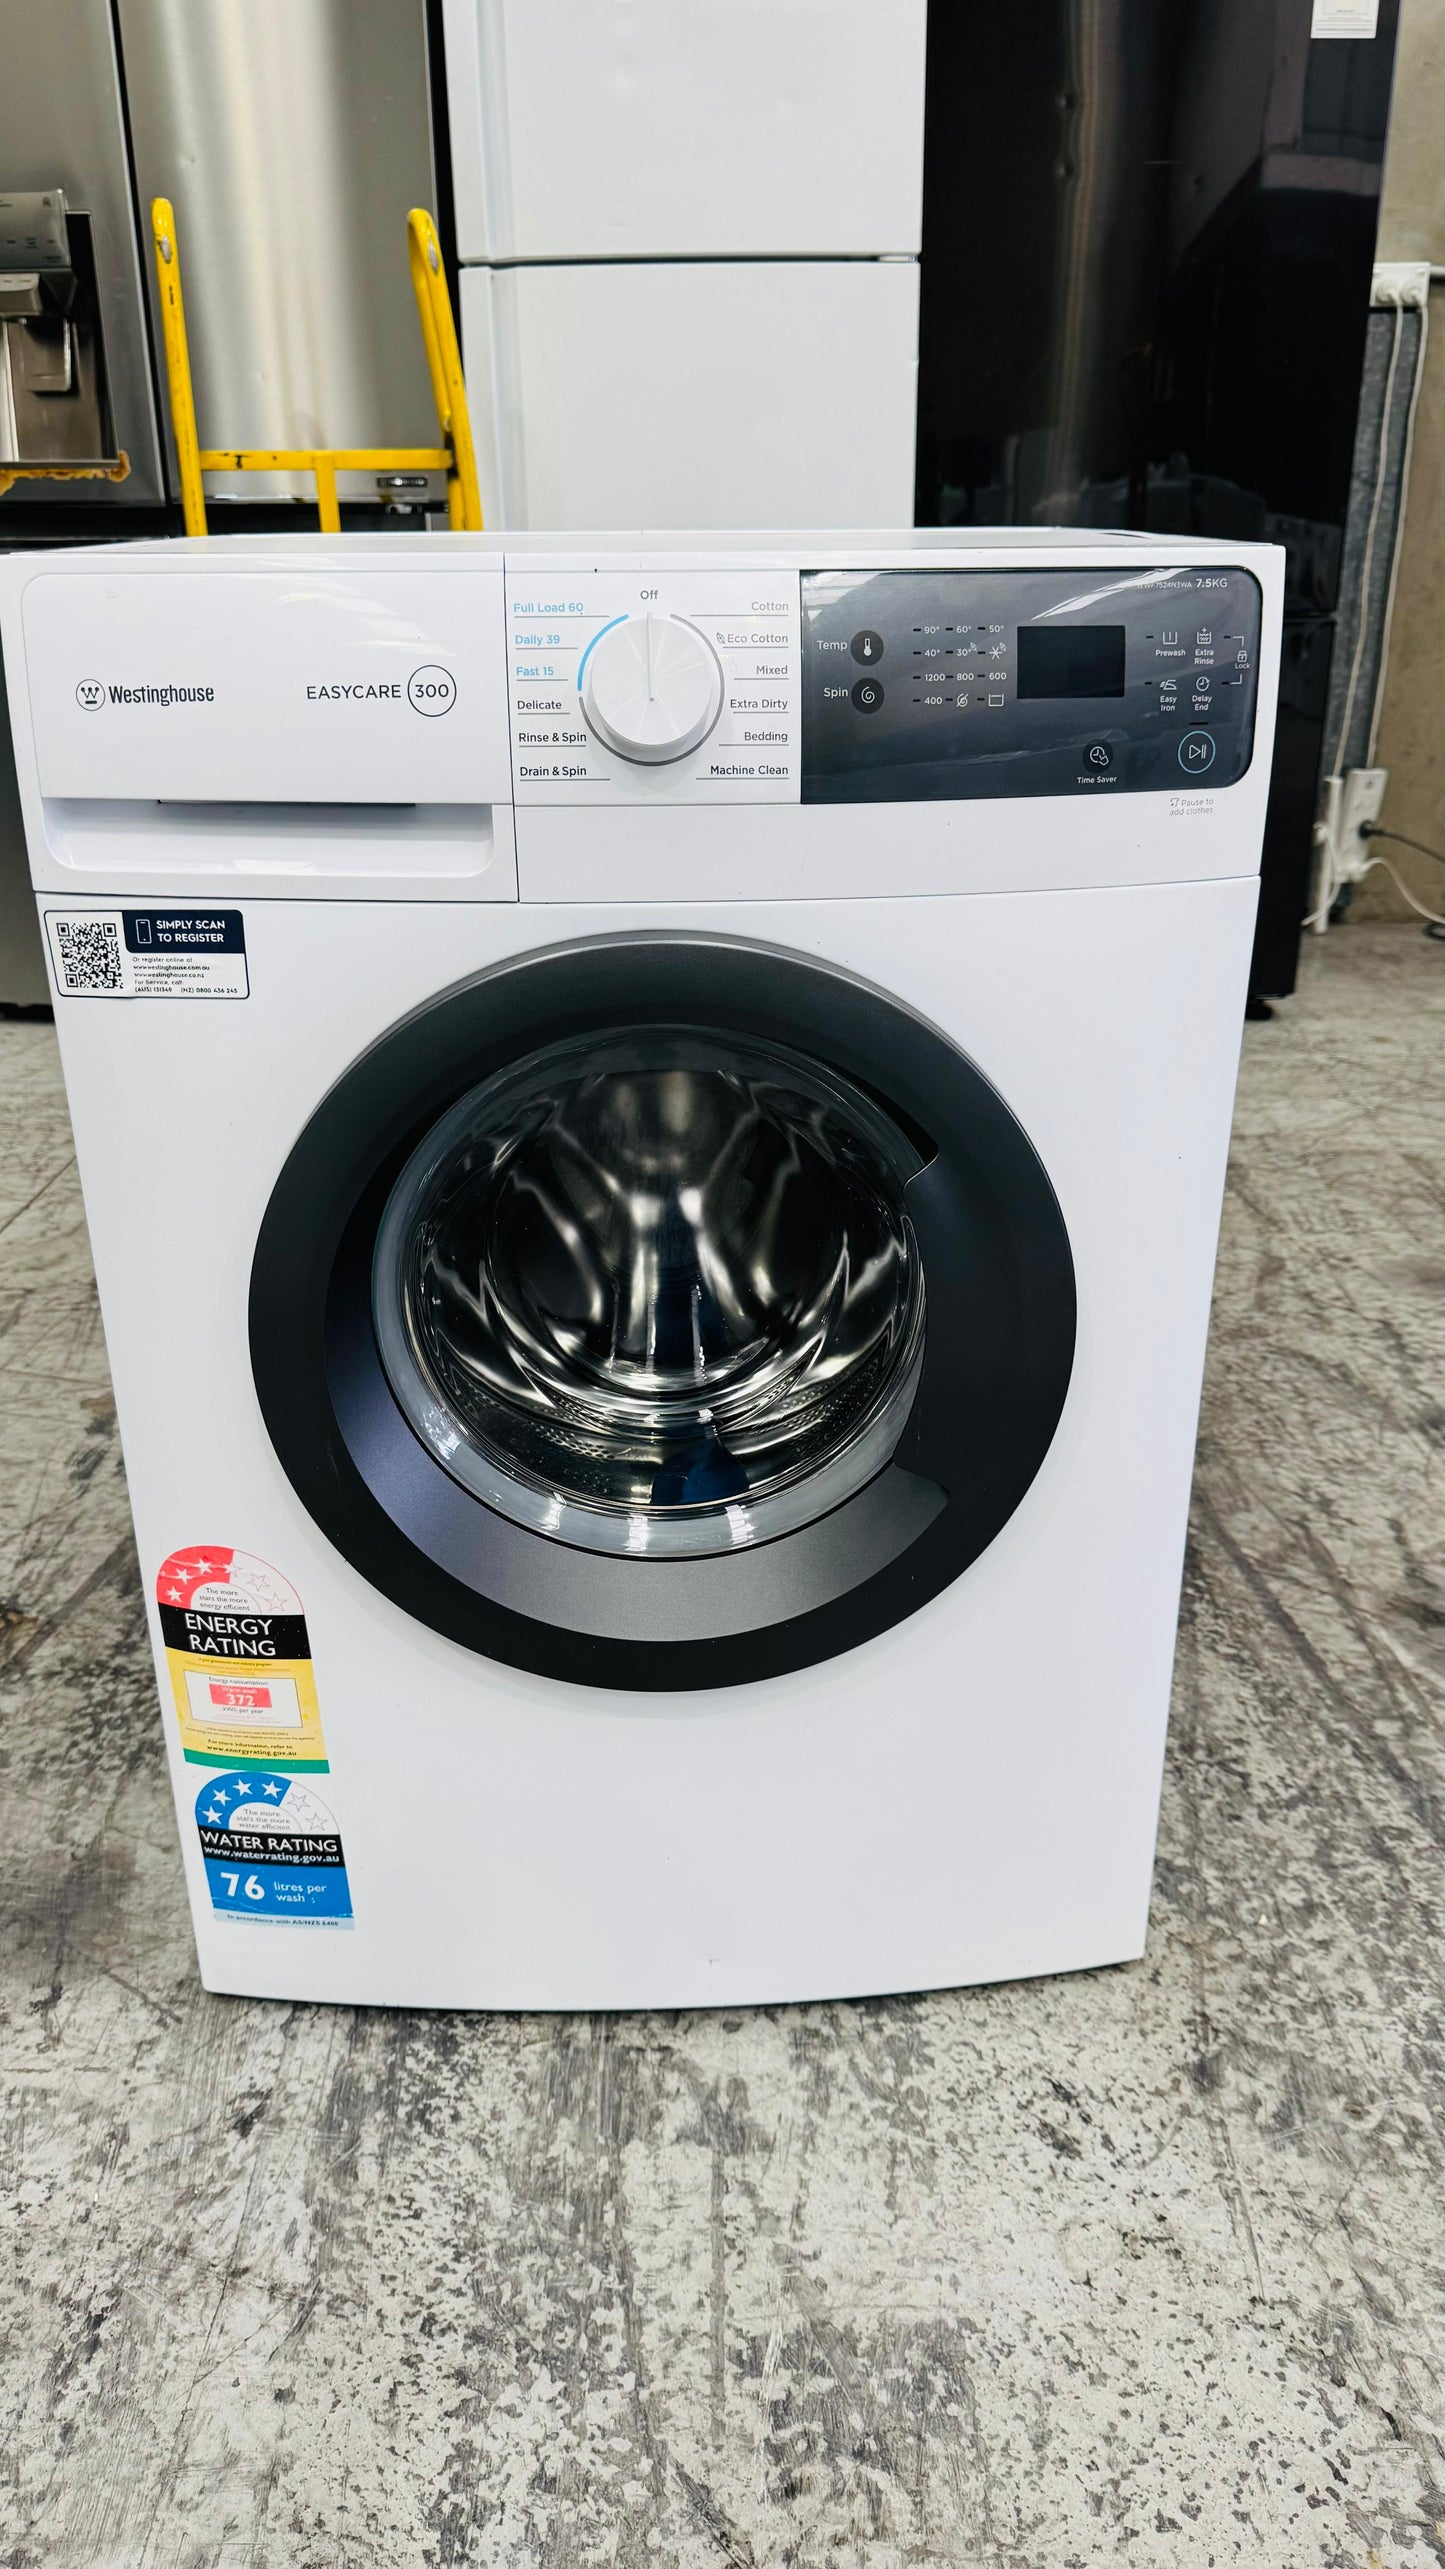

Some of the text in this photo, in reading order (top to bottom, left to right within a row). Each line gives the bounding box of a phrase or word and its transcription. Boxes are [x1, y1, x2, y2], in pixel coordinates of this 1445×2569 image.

[1195, 578, 1228, 588] 7.5KG
[640, 590, 659, 600] Off
[513, 603, 584, 613] Full Load 60
[751, 601, 789, 611] Cotton
[515, 635, 560, 646] Daily 39
[727, 633, 788, 643] Eco Cotton
[817, 640, 848, 652] Temp
[1155, 649, 1186, 657] Prewash
[516, 667, 554, 676] Fast 15
[756, 665, 788, 675] Mixed
[989, 672, 1006, 680] 600
[108, 685, 215, 707] Westinghouse
[306, 683, 450, 700] EASYCARE 300
[823, 686, 848, 699] Spin
[1160, 696, 1177, 704] Easy
[1192, 695, 1213, 703] Delay
[517, 700, 562, 710] Delicate
[730, 699, 788, 710] Extra Dirty
[1195, 703, 1209, 711] End
[518, 732, 587, 744] Rinse & Spin
[744, 731, 788, 742] Bedding
[520, 766, 587, 778] Drain & Spin
[710, 765, 789, 775] Machine Clean
[1077, 775, 1117, 784] Time Saver
[1181, 799, 1203, 807] Pause
[1186, 807, 1214, 815] clothes
[156, 919, 226, 930] SIMPLY SCAN
[157, 932, 224, 943] TO REGISTER
[185, 1613, 272, 1635] ENERGY
[189, 1634, 276, 1656] RATING
[227, 1693, 255, 1706] 372
[201, 1829, 338, 1852] WATER RATING
[204, 1846, 340, 1864] www.waterrating.gov.au
[220, 1872, 265, 1900] 76
[273, 1882, 327, 1894] litres per
[276, 1894, 305, 1902] wash
